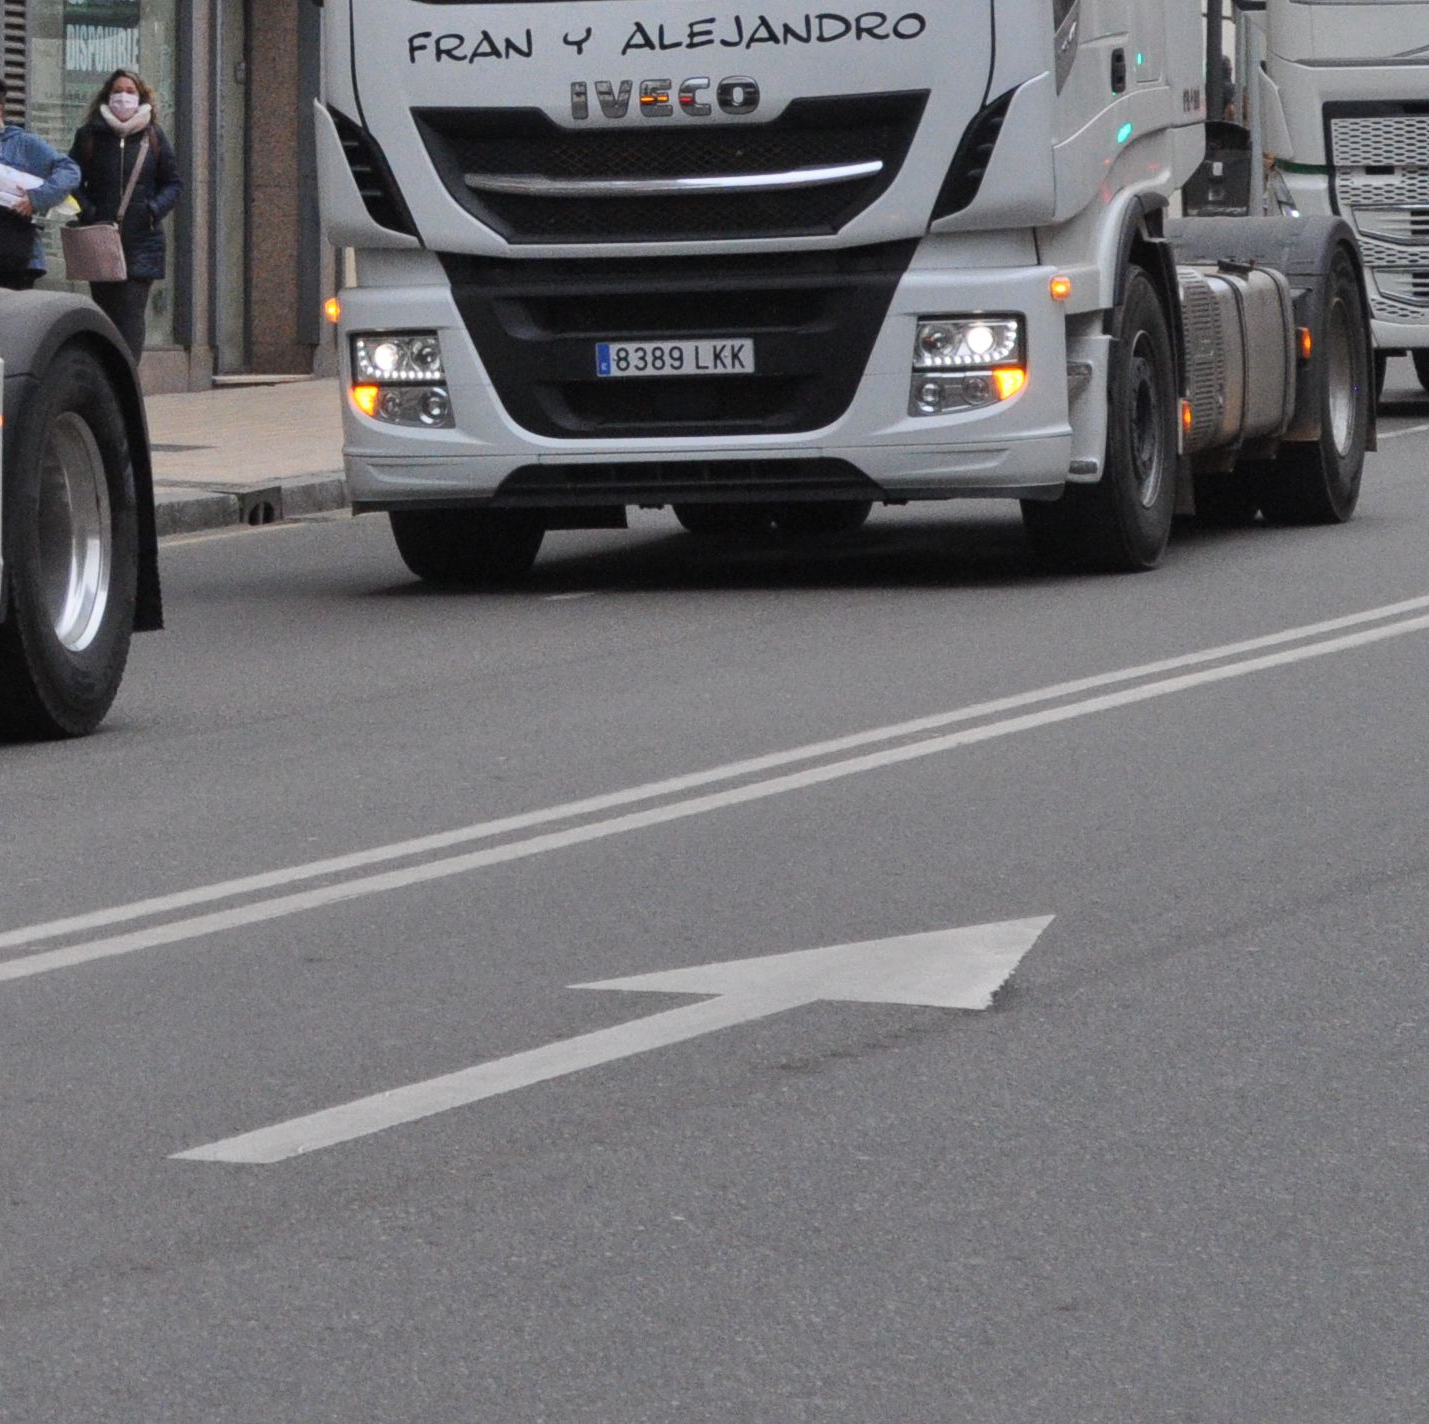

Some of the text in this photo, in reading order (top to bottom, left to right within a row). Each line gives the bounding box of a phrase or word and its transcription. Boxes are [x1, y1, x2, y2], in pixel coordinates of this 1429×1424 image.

[65, 23, 139, 74] DISPONIBLE
[407, 10, 928, 65] FRAN Y ALEJANDRO
[569, 76, 762, 121] IVECO
[615, 345, 685, 372] 8389
[694, 343, 746, 370] LKK
